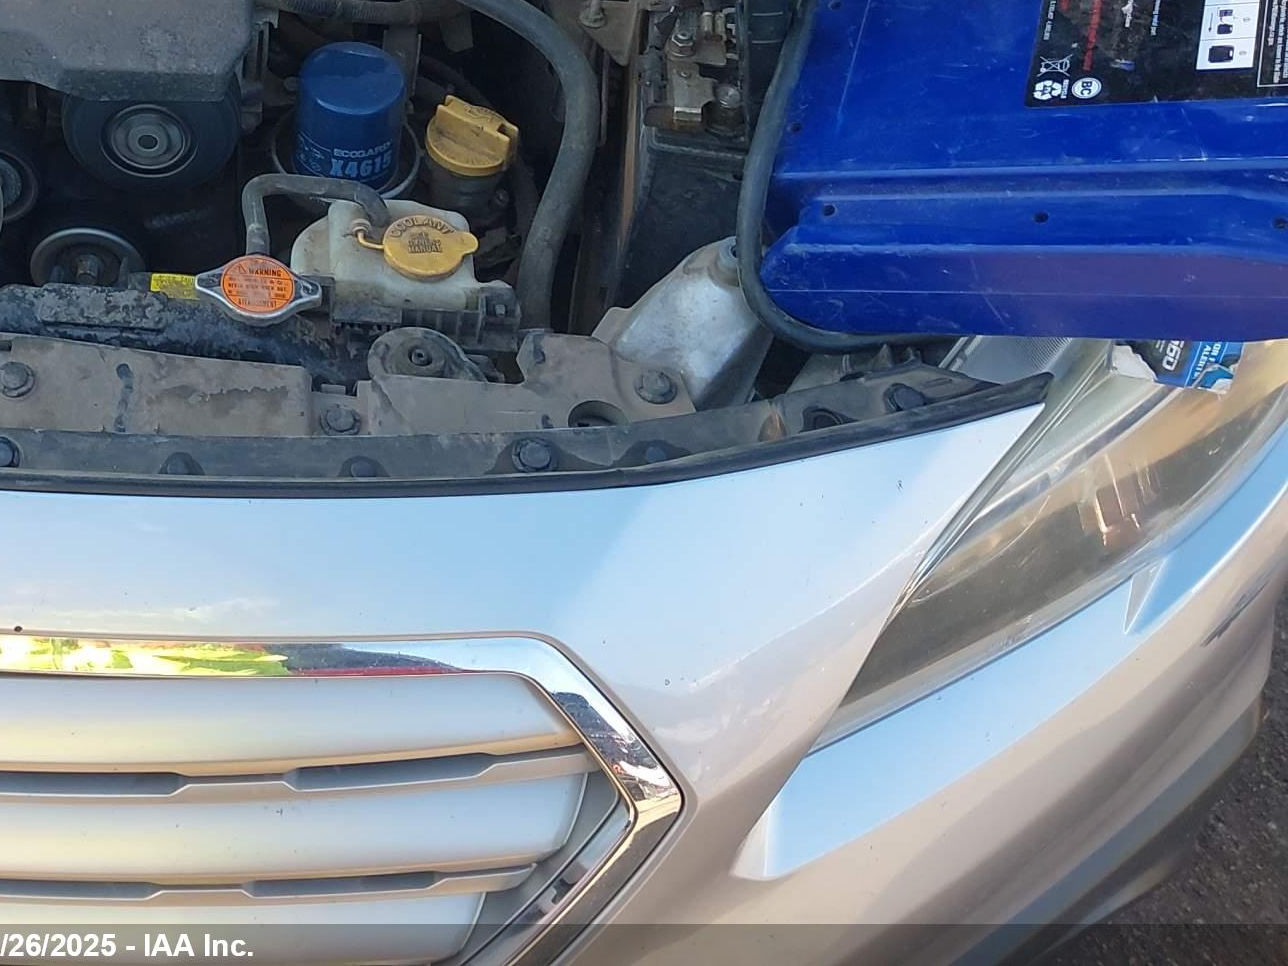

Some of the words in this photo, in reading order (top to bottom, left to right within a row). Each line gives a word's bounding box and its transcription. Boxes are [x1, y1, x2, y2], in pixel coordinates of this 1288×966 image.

[333, 139, 392, 158] ECOGARD
[329, 149, 394, 178] X4615
[390, 217, 457, 238] COOLANT
[248, 267, 282, 277] WARNING
